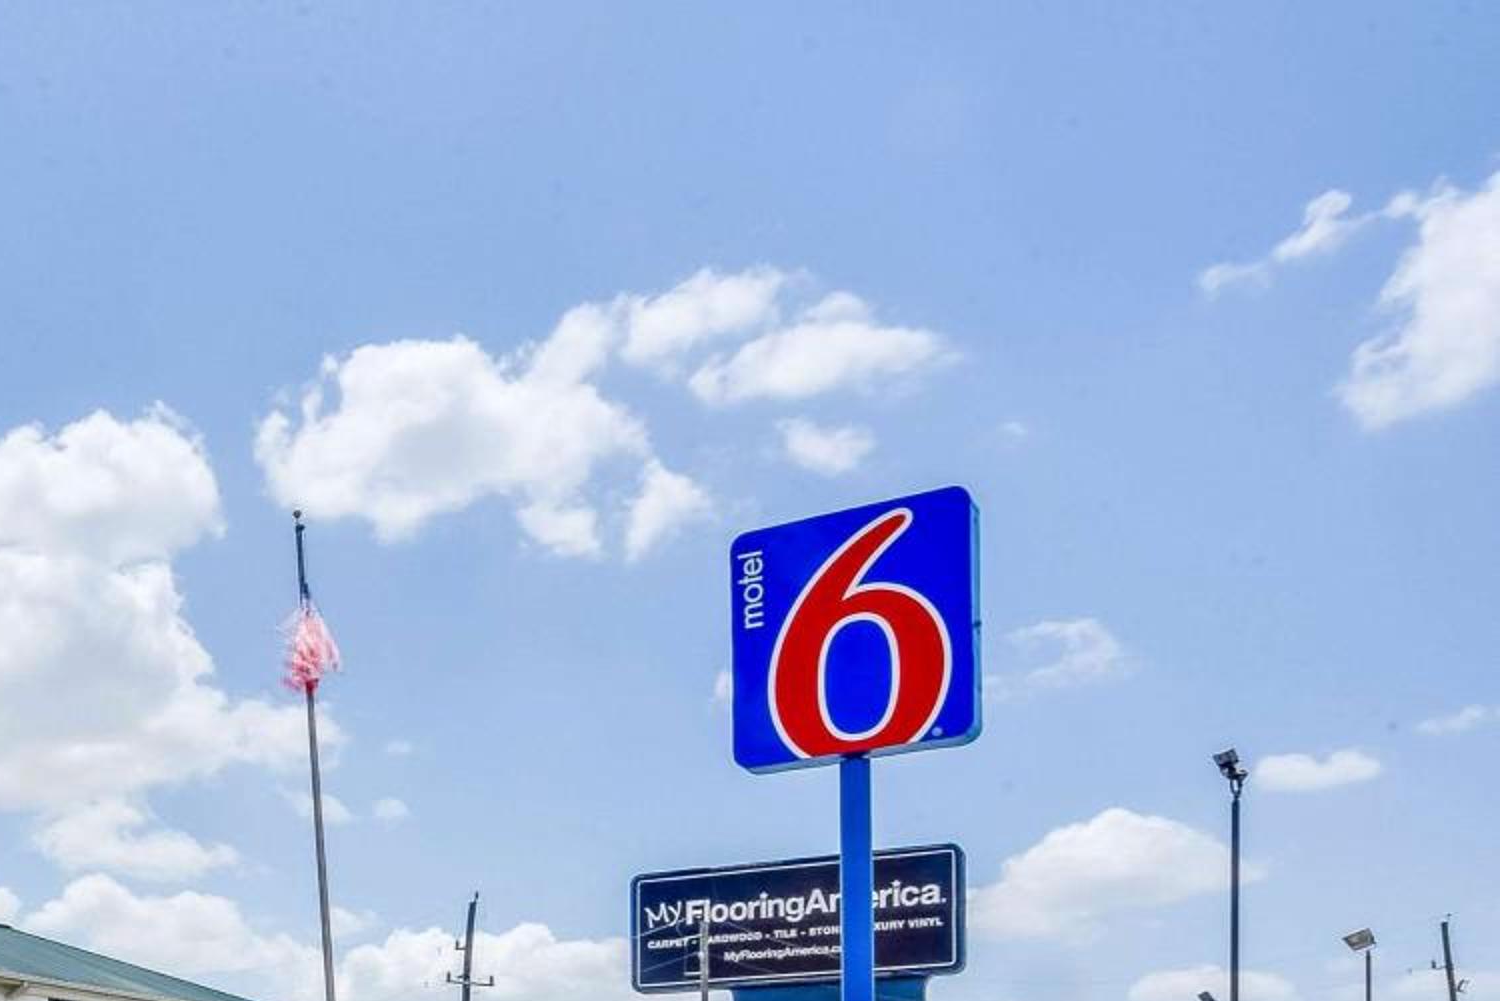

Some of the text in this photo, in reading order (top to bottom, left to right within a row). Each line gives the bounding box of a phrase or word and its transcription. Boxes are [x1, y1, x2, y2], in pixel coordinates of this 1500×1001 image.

[737, 549, 764, 630] motel
[767, 507, 953, 760] 6
[647, 938, 690, 949] CARPET
[707, 931, 763, 944] ARDWOOD
[773, 928, 797, 939] TILE
[808, 926, 841, 937] STON
[908, 917, 944, 928] VINYL
